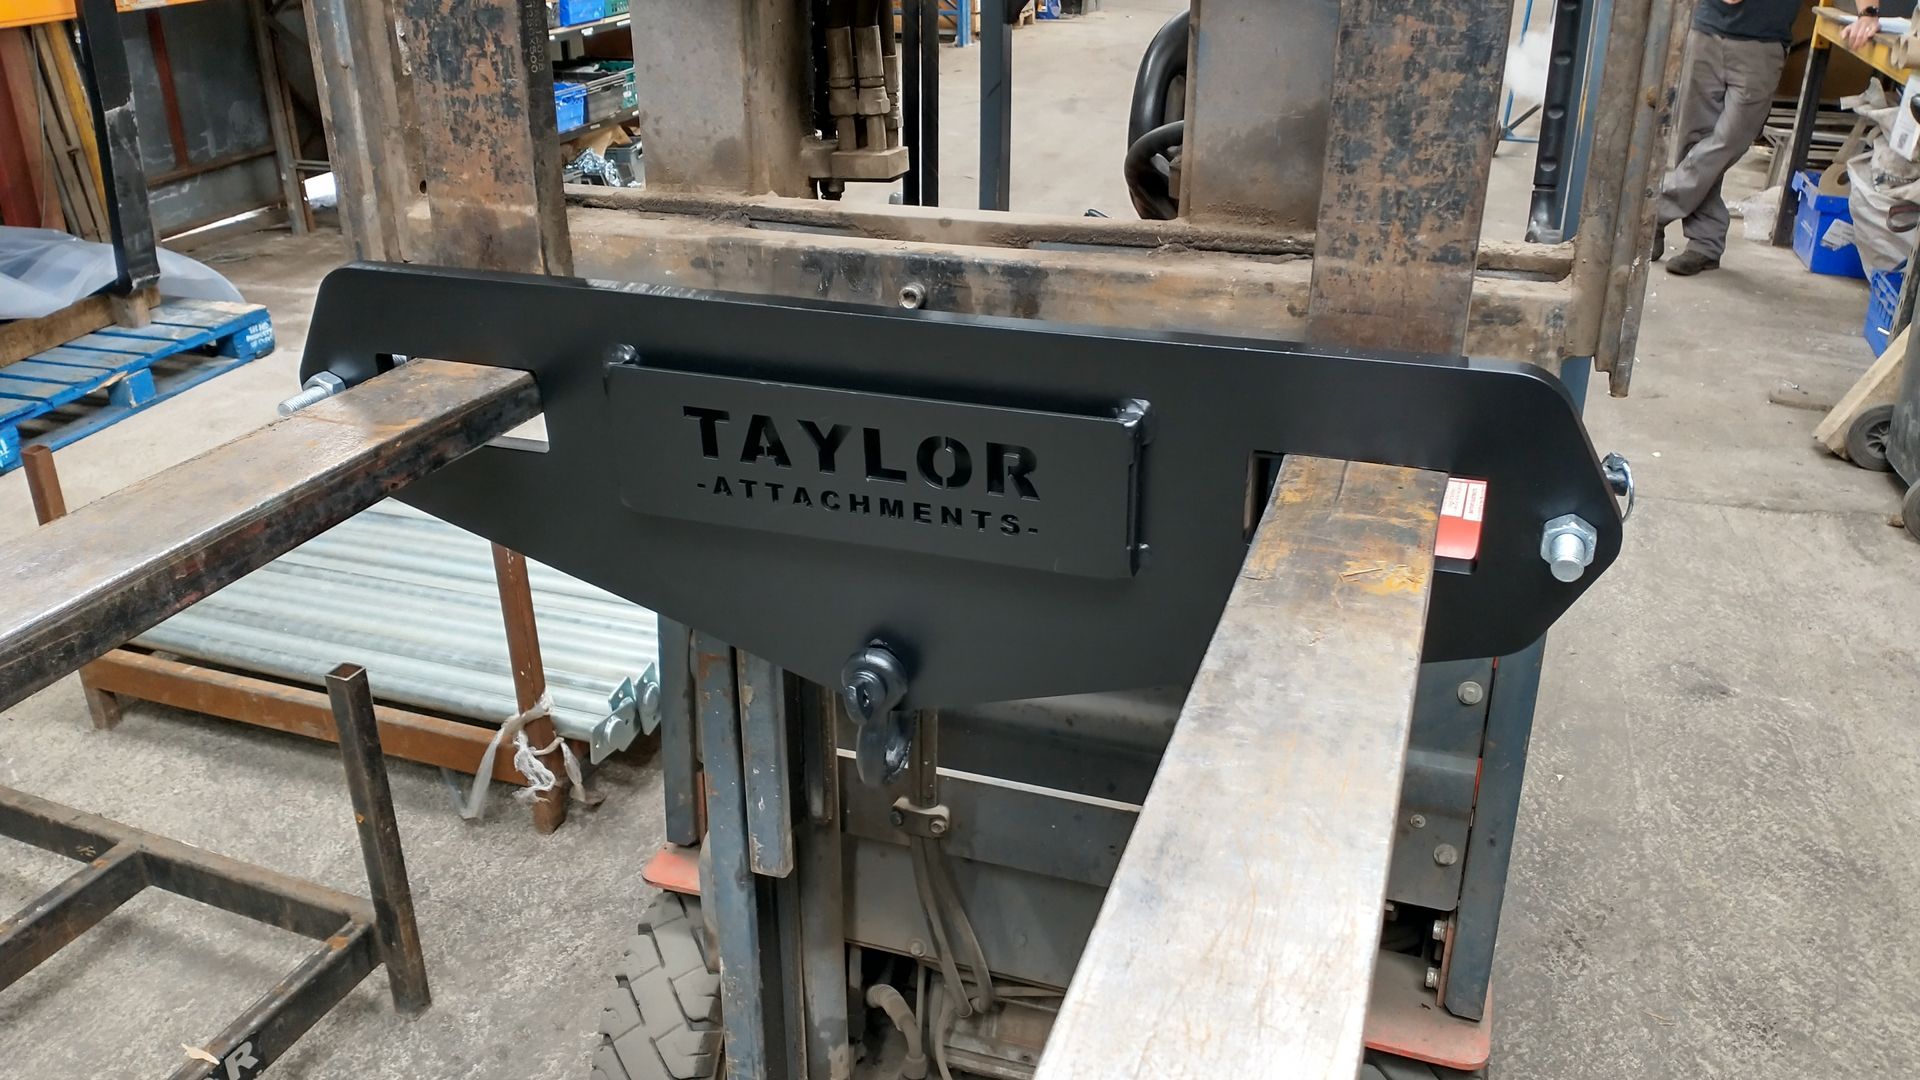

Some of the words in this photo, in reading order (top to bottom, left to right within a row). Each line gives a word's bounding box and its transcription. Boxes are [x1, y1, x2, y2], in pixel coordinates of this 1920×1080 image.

[683, 405, 1041, 501] TAYLOR
[696, 475, 1039, 536] -ATTACHMENTS-
[206, 1041, 259, 1080] R
